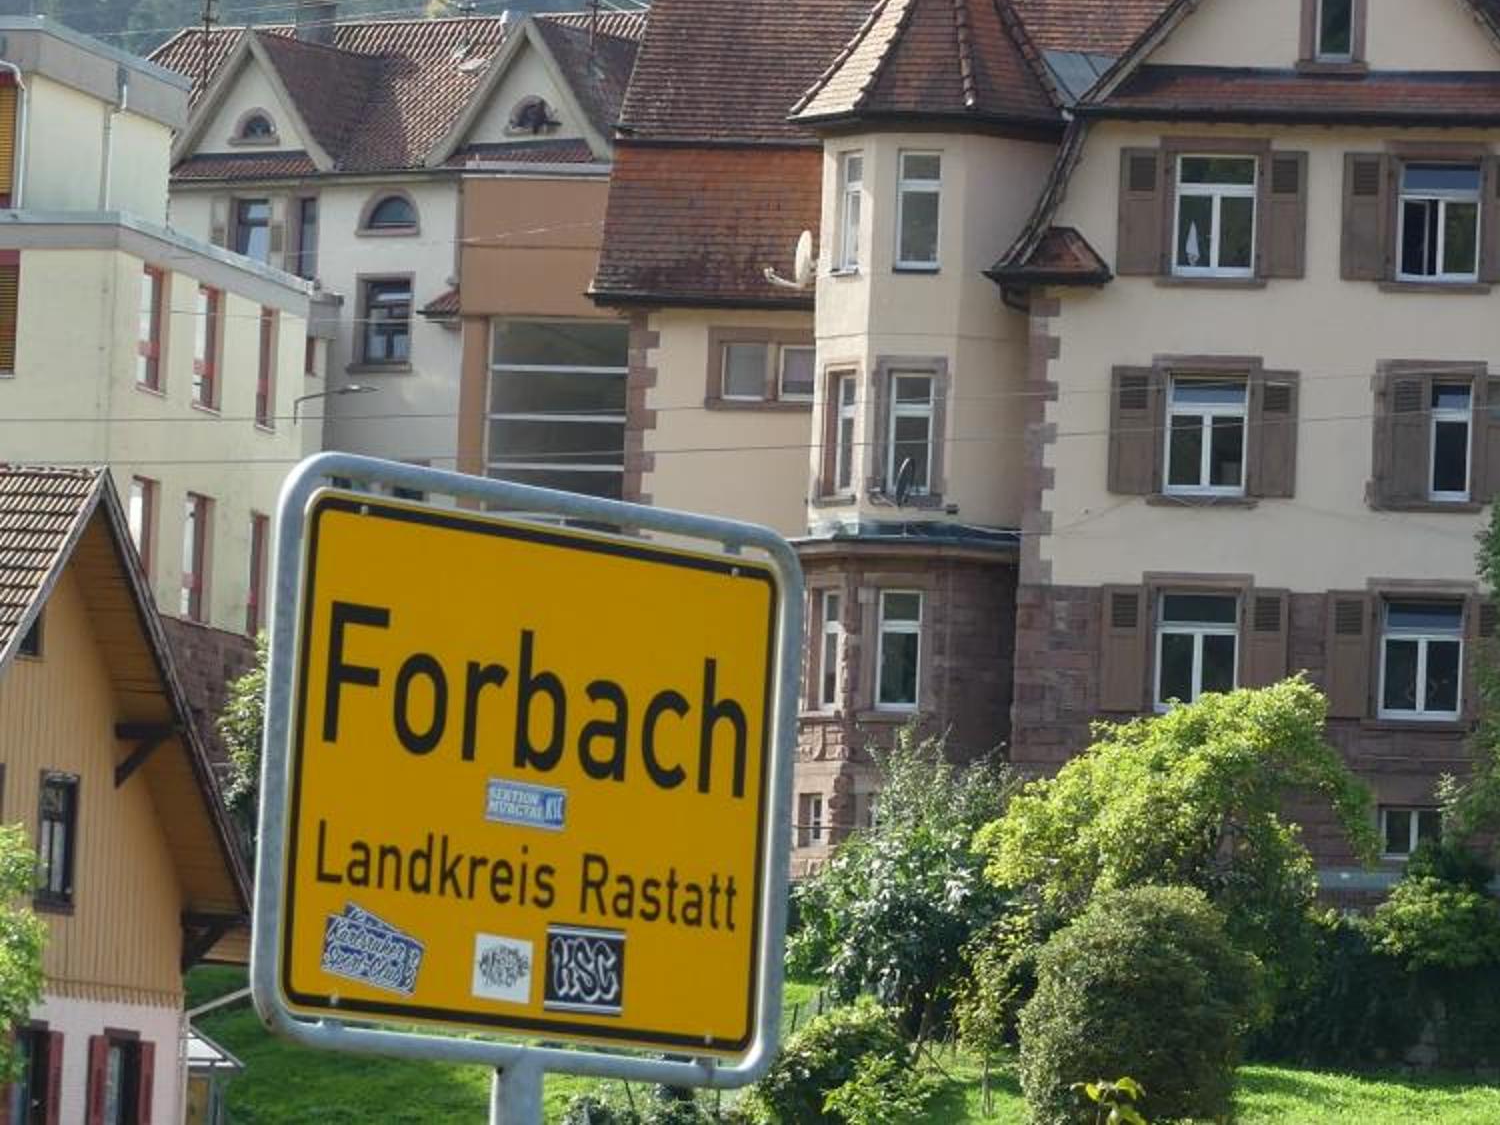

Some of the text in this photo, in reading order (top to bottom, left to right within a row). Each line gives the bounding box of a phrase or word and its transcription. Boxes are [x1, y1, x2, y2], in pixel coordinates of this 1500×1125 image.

[322, 601, 749, 800] Forbach
[315, 819, 738, 933] Landkreis Rastatt
[551, 936, 618, 1002] KSC
